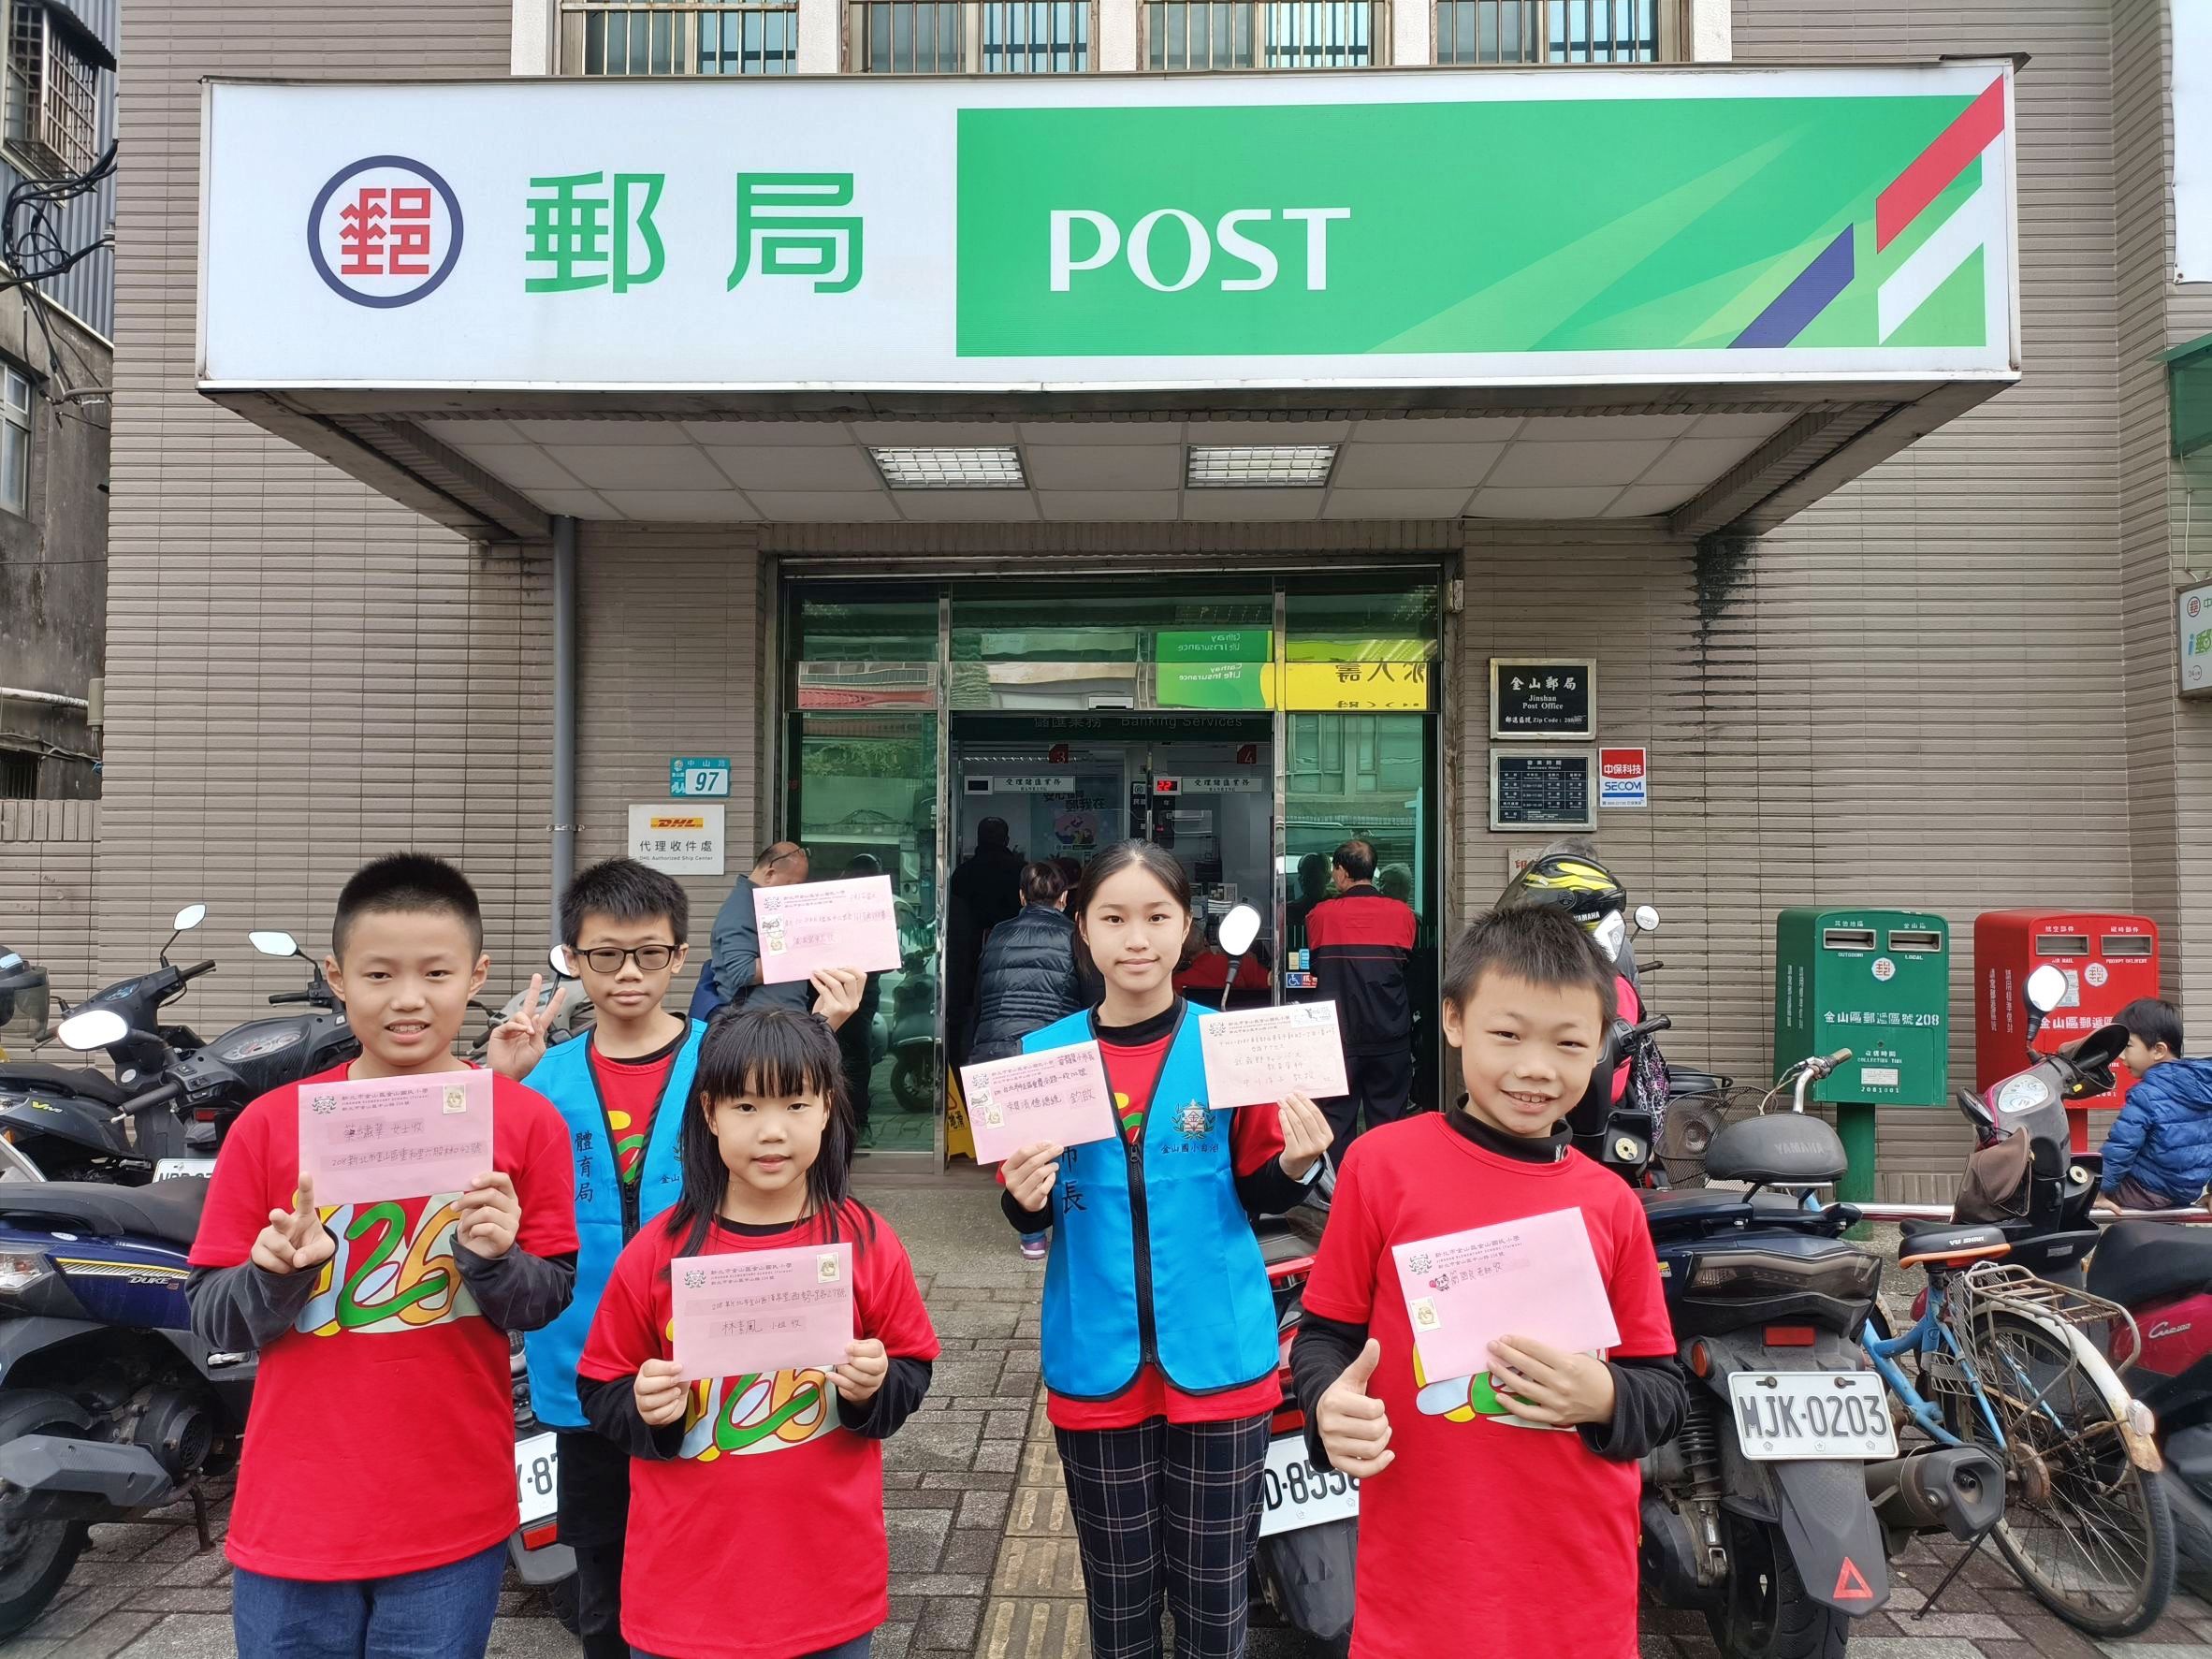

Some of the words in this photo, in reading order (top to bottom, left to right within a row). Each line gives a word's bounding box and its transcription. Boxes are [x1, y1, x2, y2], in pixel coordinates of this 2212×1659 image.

[525, 170, 864, 294] 郵局
[1050, 207, 1351, 292] POST
[1510, 676, 1577, 691] 金山郵局
[1604, 764, 1641, 775] 中保科技
[695, 772, 719, 792] 97
[1605, 781, 1641, 791] SECOM
[658, 819, 696, 828] DHL
[639, 840, 712, 852] 代理收件處
[575, 1129, 593, 1203] 體育局
[659, 1173, 680, 1185] 金山
[129, 1275, 171, 1284] DUKE
[1739, 1395, 1887, 1437] MJK-0203
